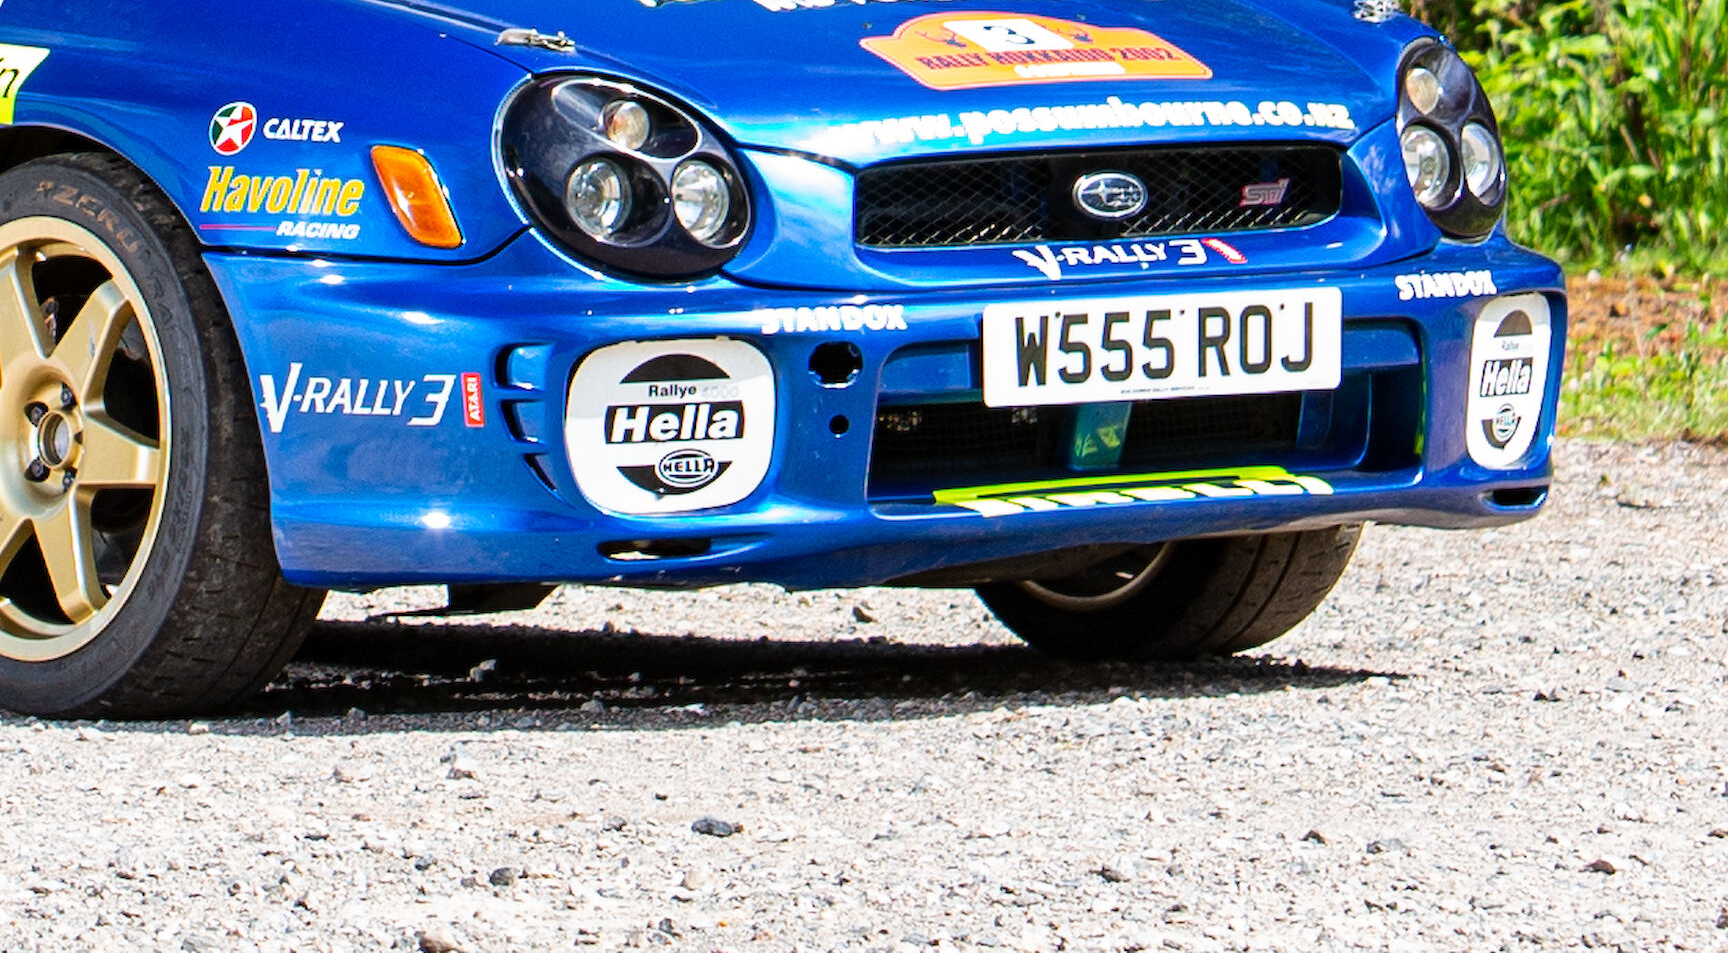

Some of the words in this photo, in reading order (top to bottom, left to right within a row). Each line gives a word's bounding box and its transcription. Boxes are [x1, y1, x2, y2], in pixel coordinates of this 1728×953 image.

[916, 52, 991, 70] RALLY
[988, 48, 1115, 66] HOKKAIDO
[1110, 47, 1183, 62] 2002
[263, 118, 344, 143] CALTEX
[830, 96, 1355, 145] www.possumbourne.co.nz
[199, 166, 365, 216] Havoline
[276, 221, 361, 240] RACING
[1013, 243, 1166, 280] V-RALLY
[1169, 239, 1207, 265] 3
[1395, 270, 1497, 300] STANDOX
[760, 304, 908, 334] STANDOX
[1015, 308, 1176, 388] W555
[1198, 302, 1314, 378] ROJ
[649, 384, 697, 399] Rallye
[1481, 359, 1533, 397] Hella
[259, 362, 416, 433] V-RALLY
[406, 374, 457, 426] 3
[467, 377, 481, 421] ATARI
[610, 403, 739, 444] Hella
[663, 457, 715, 474] HELLA
